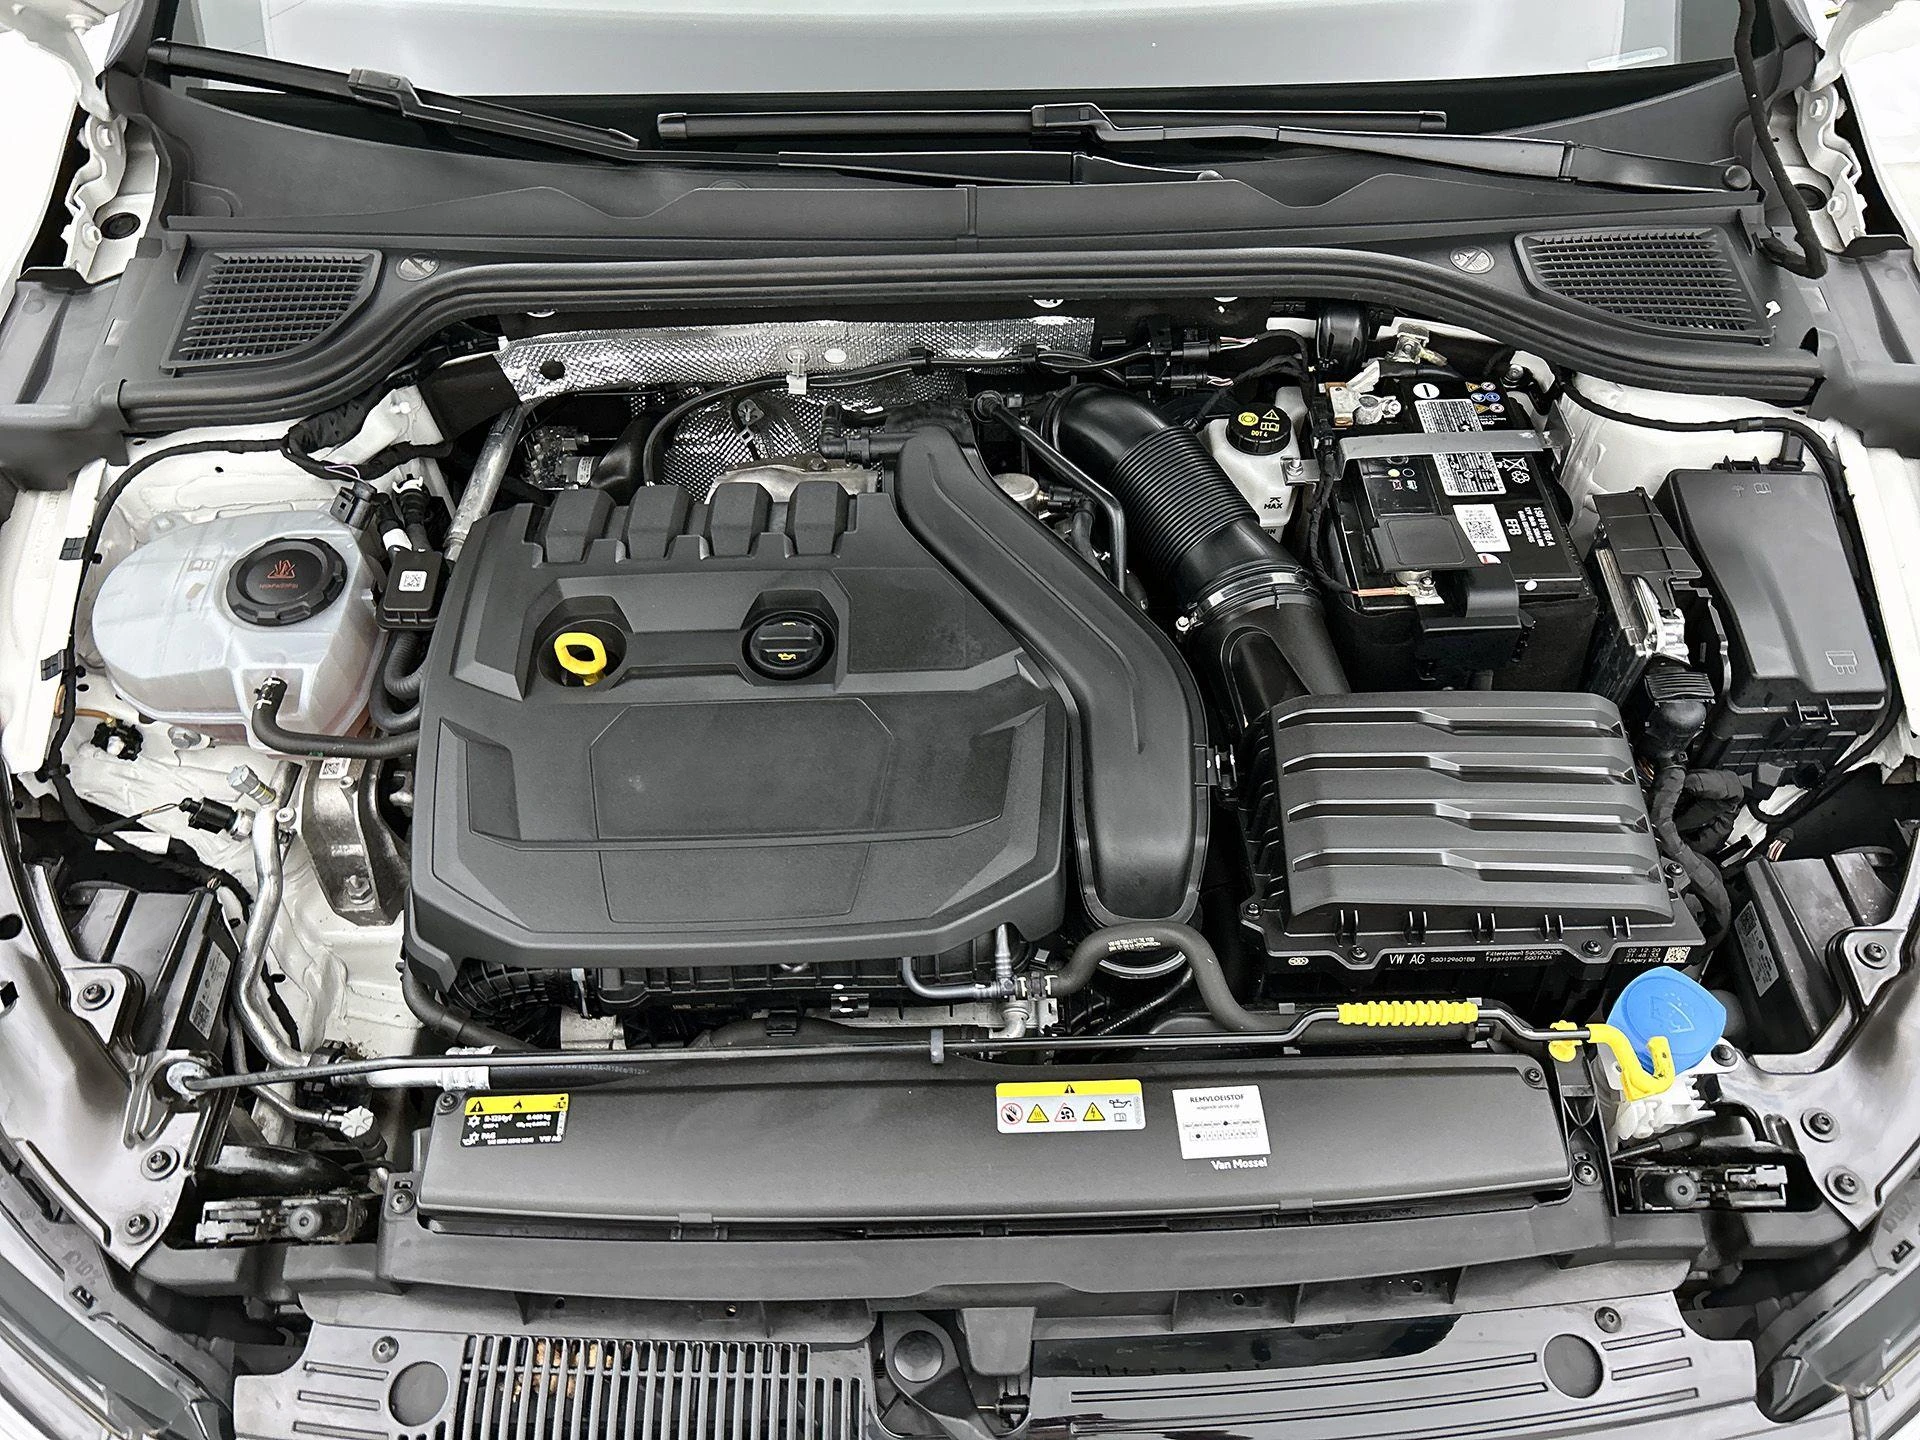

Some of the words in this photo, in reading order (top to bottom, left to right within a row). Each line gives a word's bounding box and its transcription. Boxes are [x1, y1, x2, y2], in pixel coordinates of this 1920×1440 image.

[1505, 518, 1522, 535] EFB
[1389, 954, 1405, 964] VW
[1409, 953, 1426, 965] AG
[1190, 1093, 1244, 1103] REMVLOEISTOF
[1210, 1160, 1232, 1171] Van
[1232, 1157, 1268, 1169] Mossel
